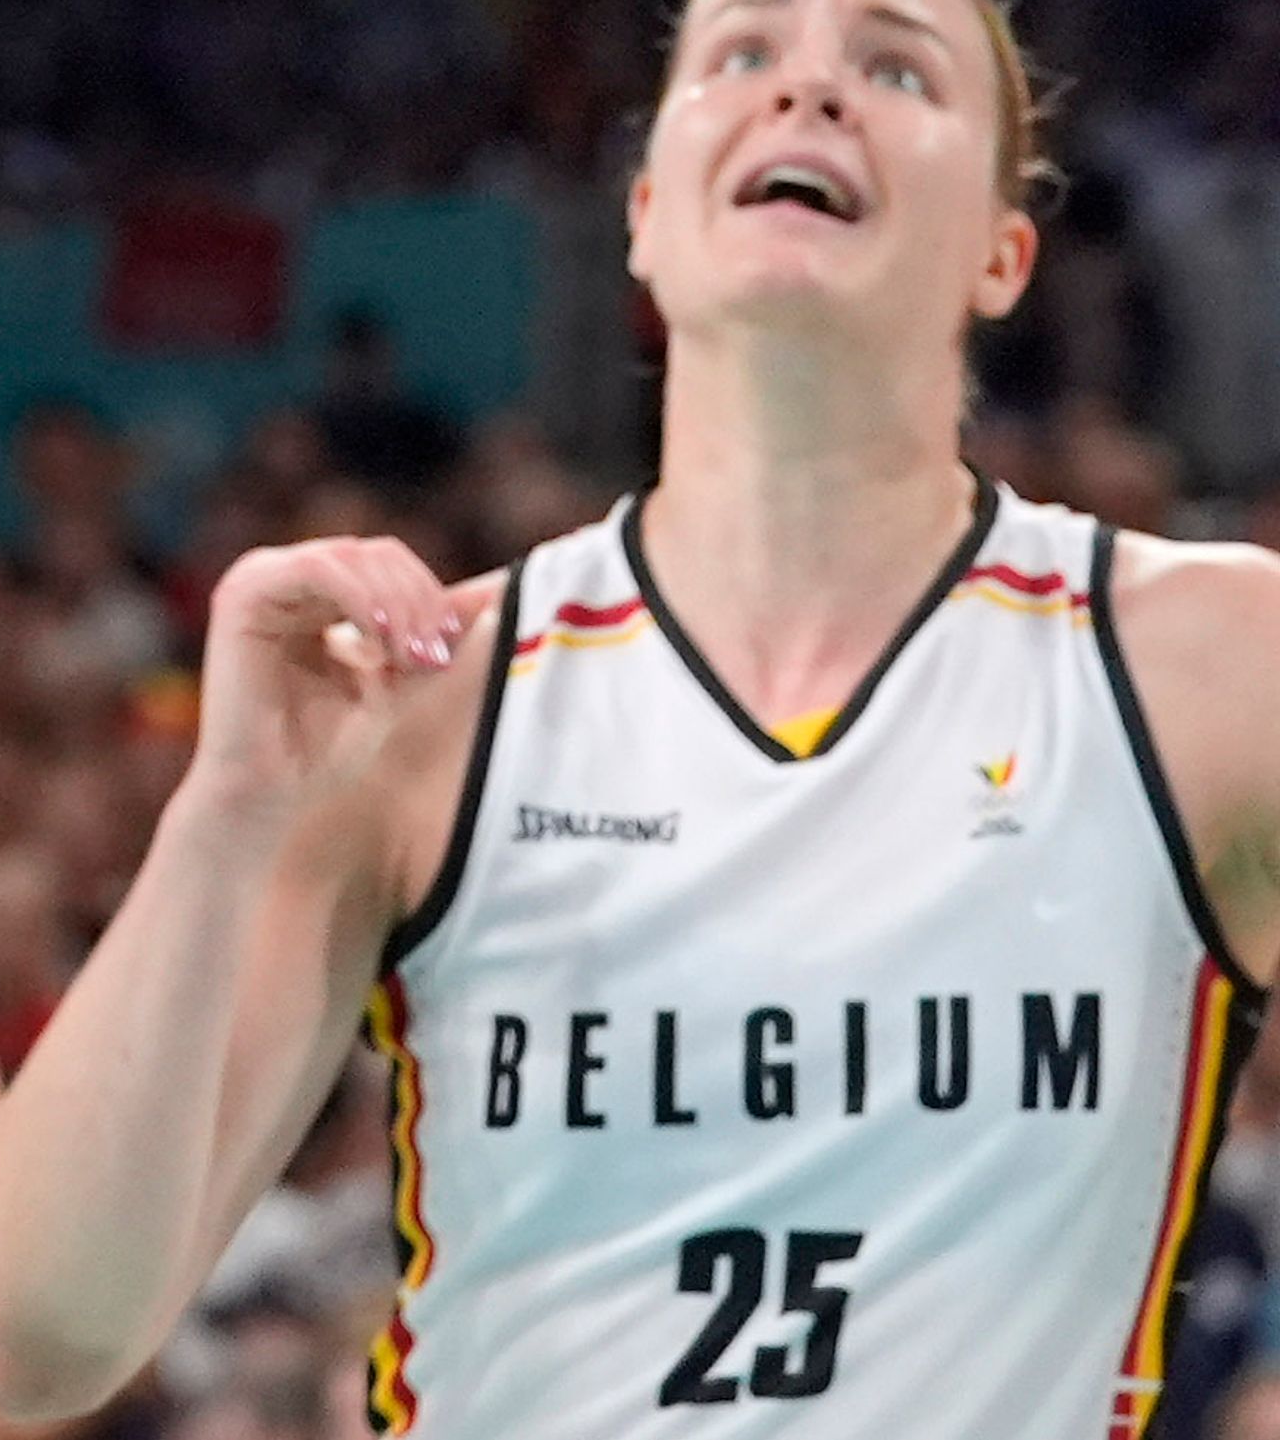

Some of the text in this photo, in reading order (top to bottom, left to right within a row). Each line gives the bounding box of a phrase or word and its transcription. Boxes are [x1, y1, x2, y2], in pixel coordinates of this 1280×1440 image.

[511, 803, 680, 844] SPALDING
[485, 993, 1102, 1130] BELGIUM
[658, 1226, 864, 1408] 25
